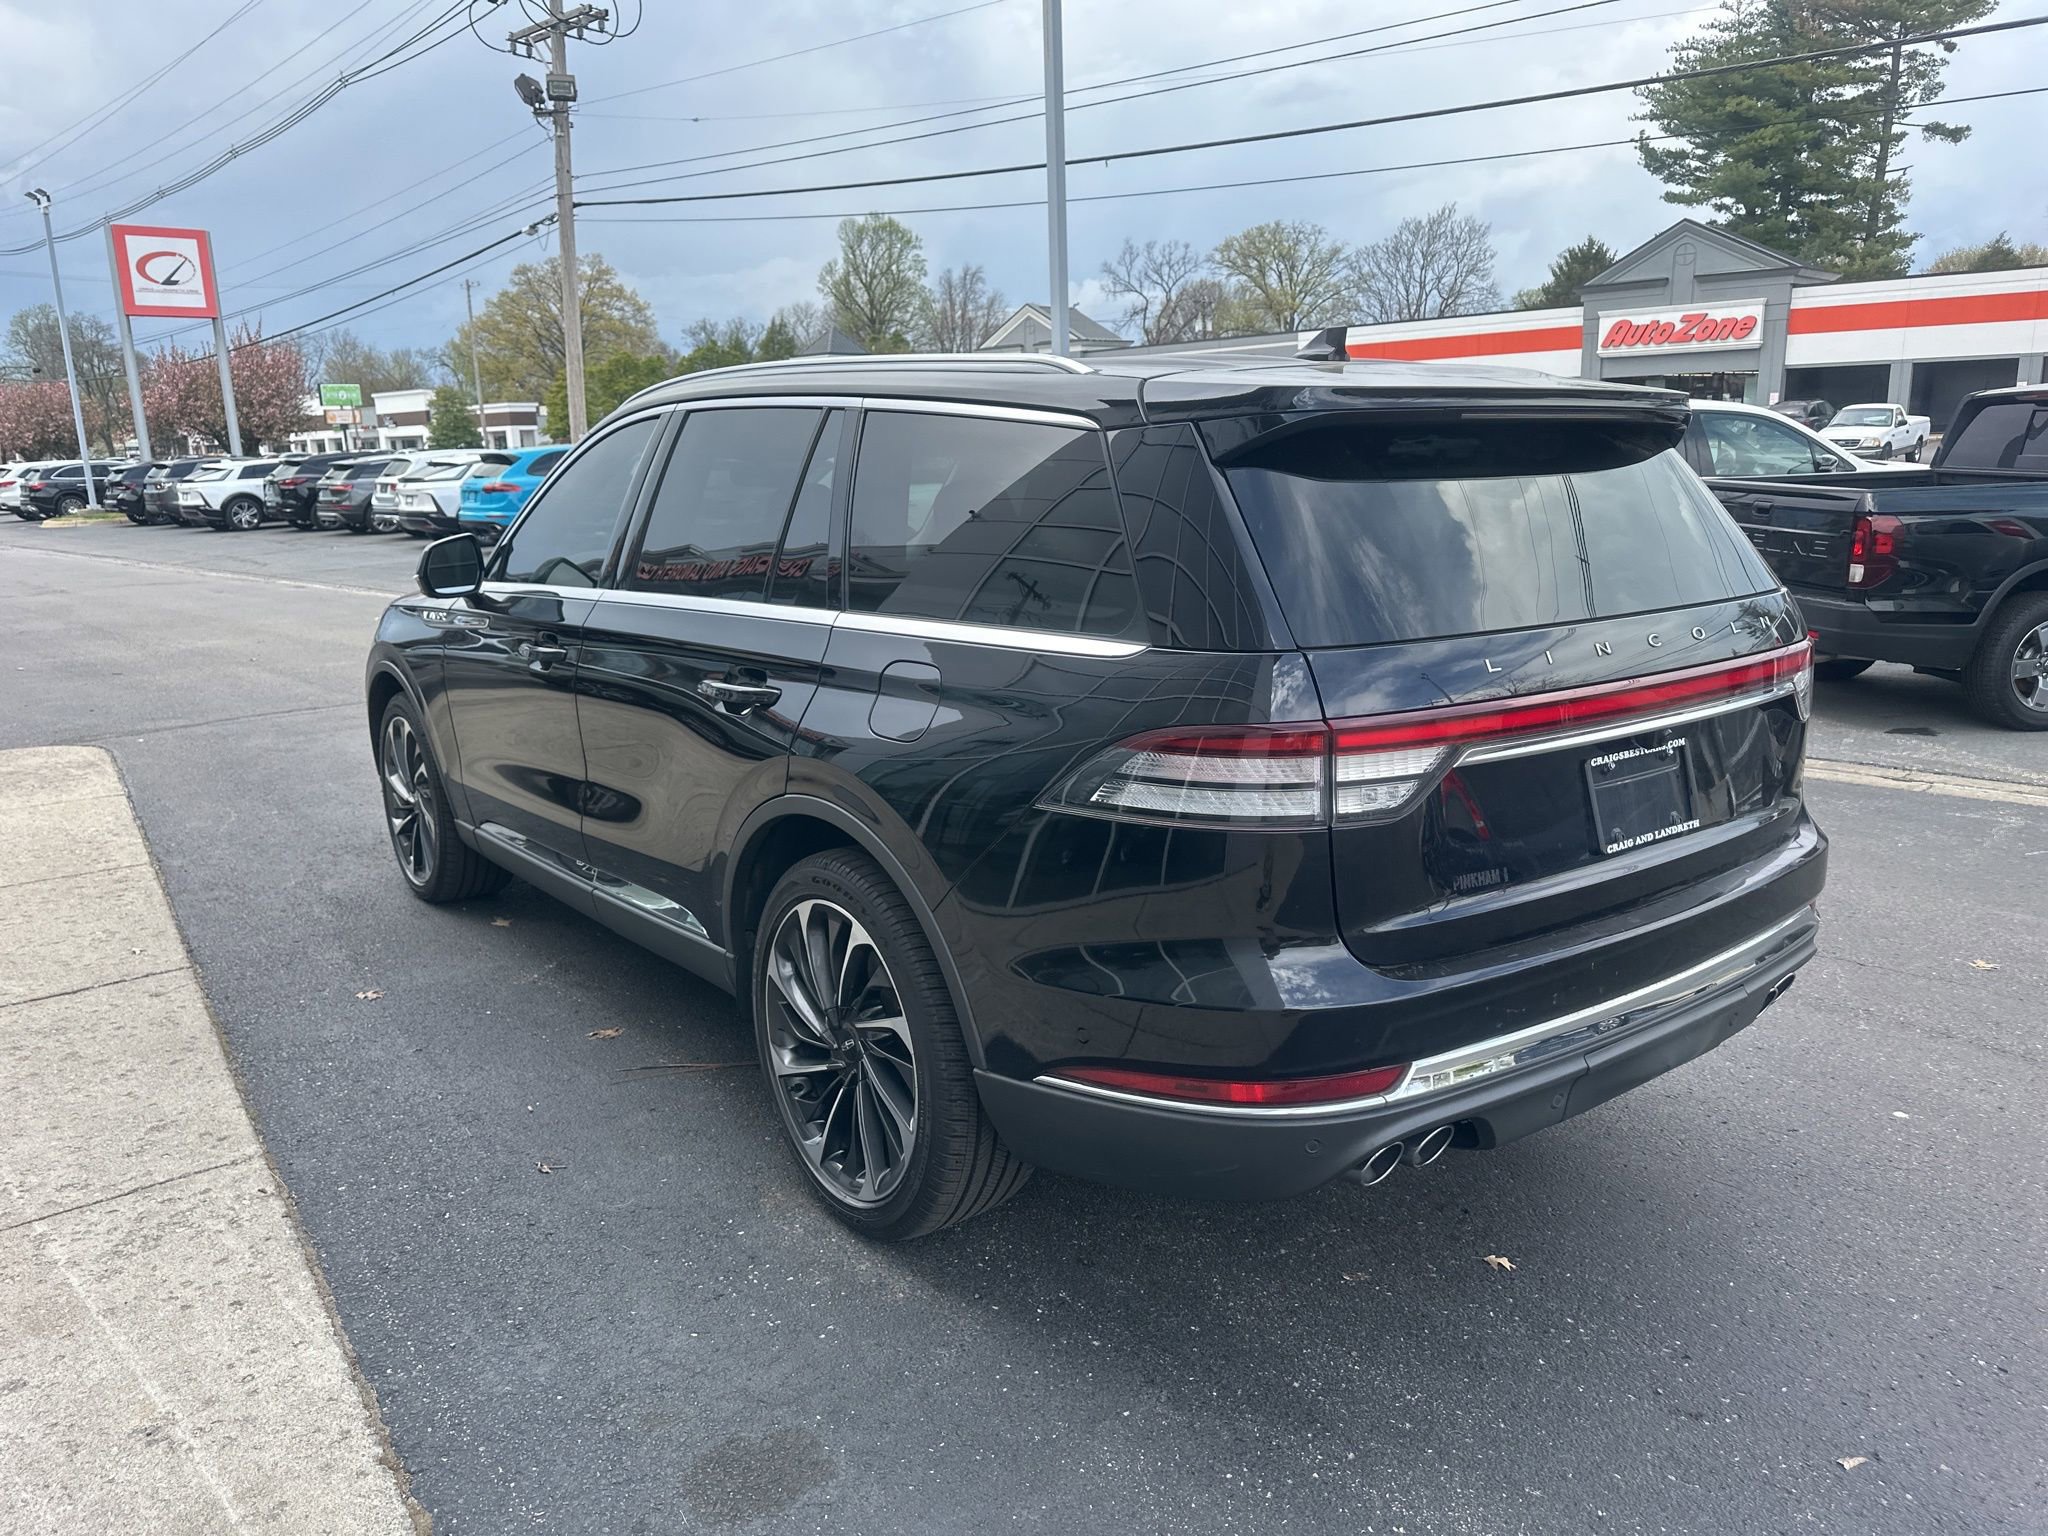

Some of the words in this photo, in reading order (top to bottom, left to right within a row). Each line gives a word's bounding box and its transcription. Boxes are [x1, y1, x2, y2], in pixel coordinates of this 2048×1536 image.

[1601, 313, 1758, 348] AutoZone
[1483, 615, 1772, 674] LINCOLN
[1606, 838, 1634, 854] CRAIG
[1635, 831, 1654, 846] AND
[1655, 819, 1700, 839] LANDRETH
[1453, 868, 1501, 891] PINKHAM
